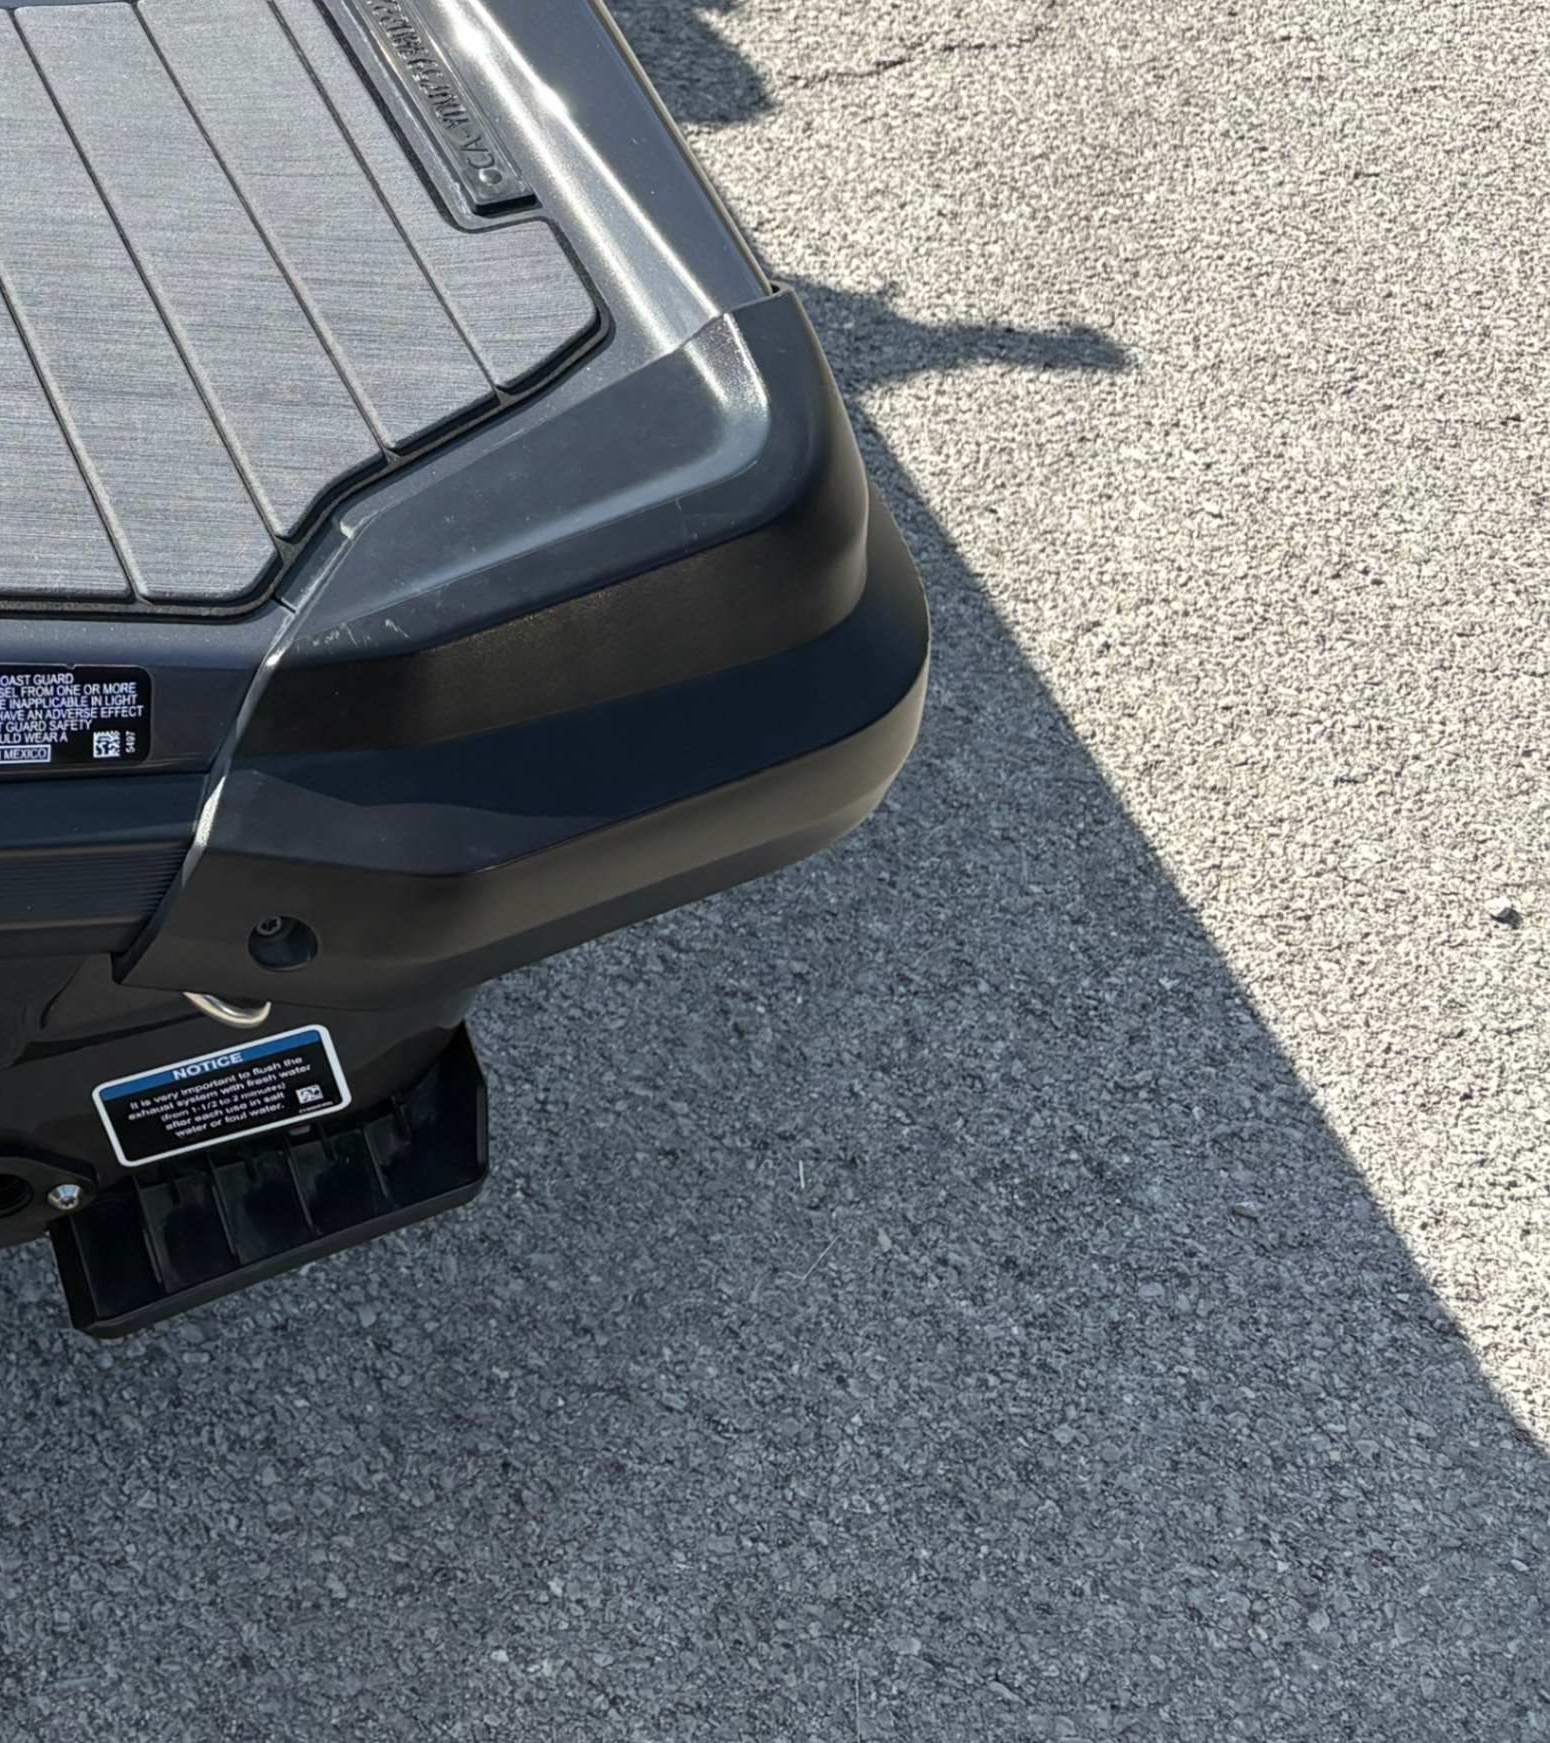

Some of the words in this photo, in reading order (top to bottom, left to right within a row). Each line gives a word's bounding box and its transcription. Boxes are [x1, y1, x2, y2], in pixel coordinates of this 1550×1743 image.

[33, 673, 73, 684] GUARD
[20, 685, 53, 697] FROM
[56, 684, 80, 695] ONE
[83, 684, 100, 695] OR
[102, 683, 136, 694] MORE
[9, 696, 88, 709] INAPPLICABLE
[90, 696, 102, 707] IN
[105, 695, 138, 706] LIGHT
[26, 709, 42, 720] AN
[45, 707, 97, 719] ADVERSE
[100, 706, 143, 717] EFFECT
[5, 721, 46, 733] GUARD
[49, 720, 92, 731] SAFETY
[24, 733, 57, 744] WEAR
[3, 748, 47, 759] MEXICO
[172, 1051, 243, 1080] NOTICE
